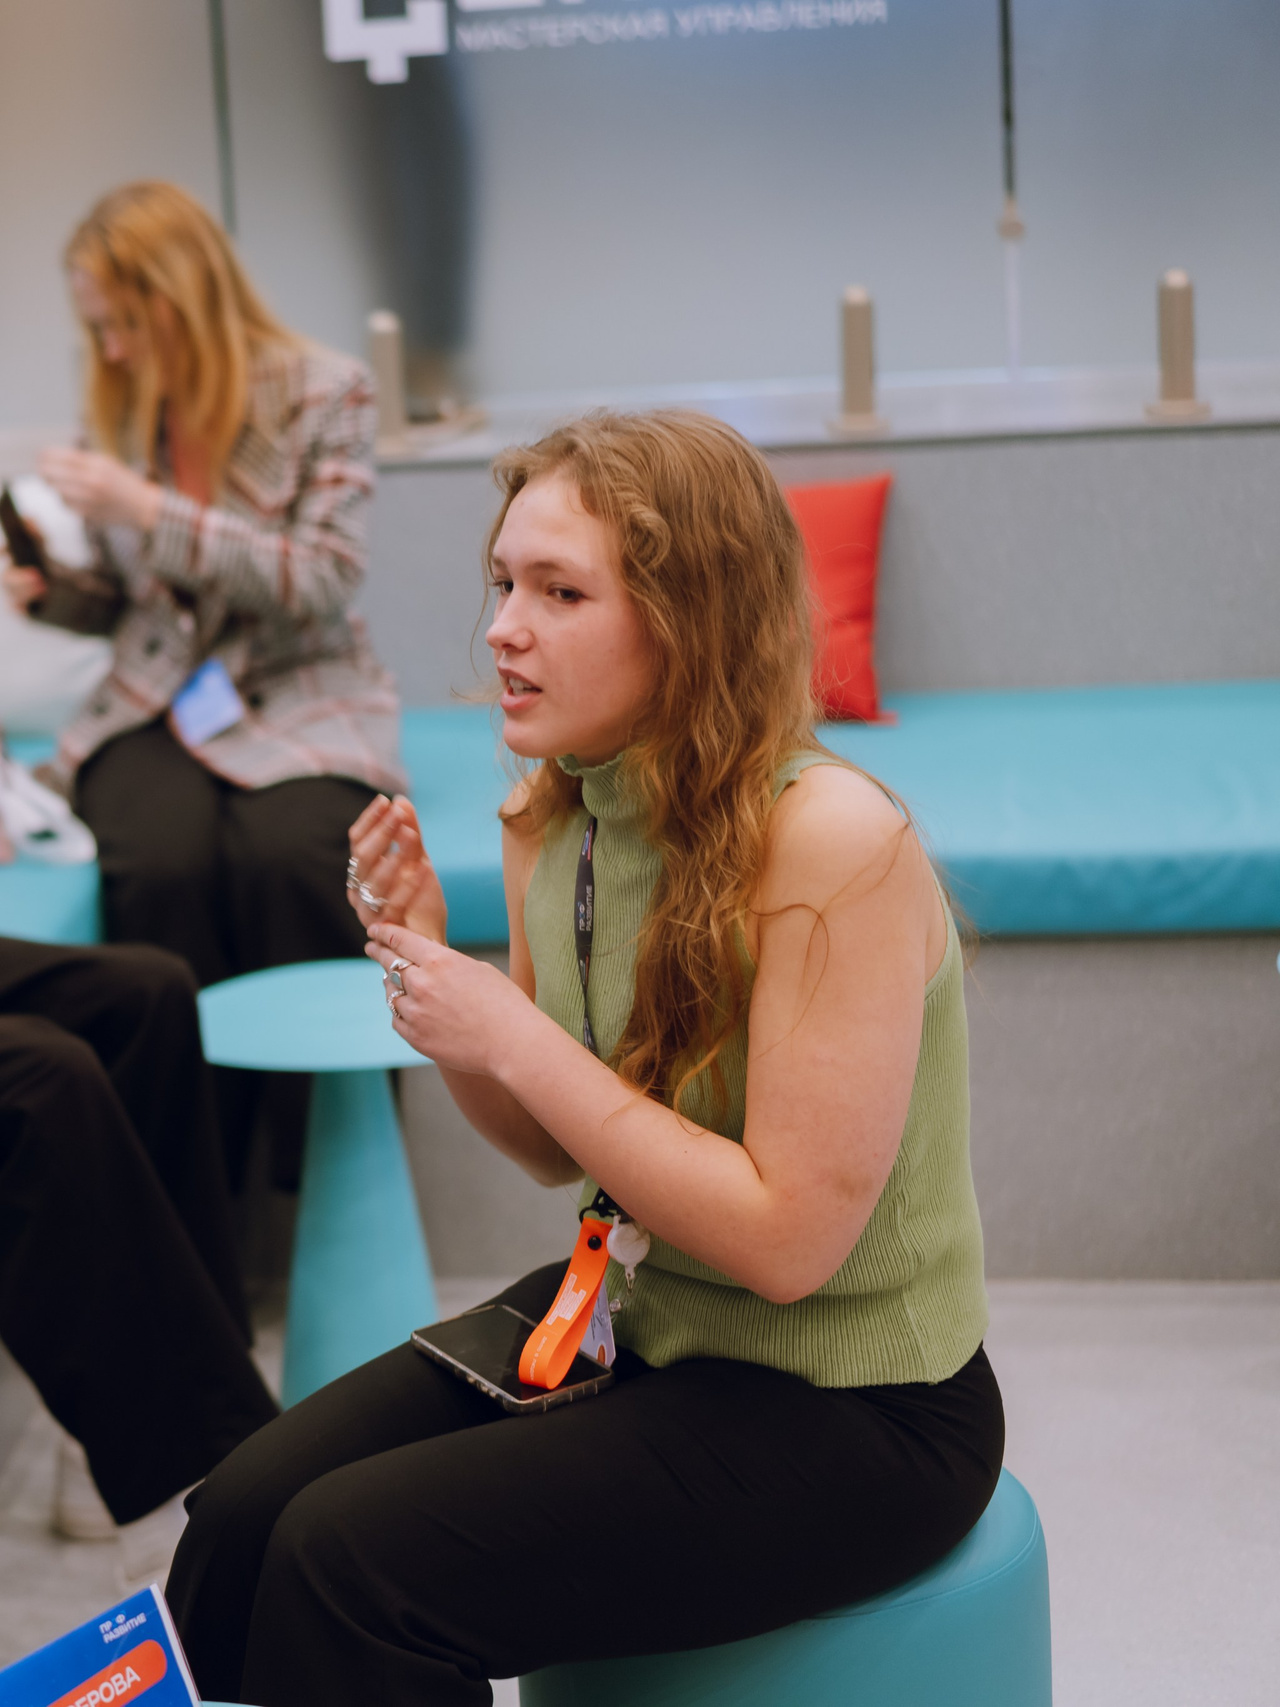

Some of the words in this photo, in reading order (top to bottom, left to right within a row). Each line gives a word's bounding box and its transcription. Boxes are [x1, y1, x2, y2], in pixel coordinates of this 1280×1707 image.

[455, 10, 670, 52] МАСТЕРСКАЯ
[103, 1612, 147, 1644] РАЗВИТИЕ
[67, 1666, 142, 1707] ЕРОВА
